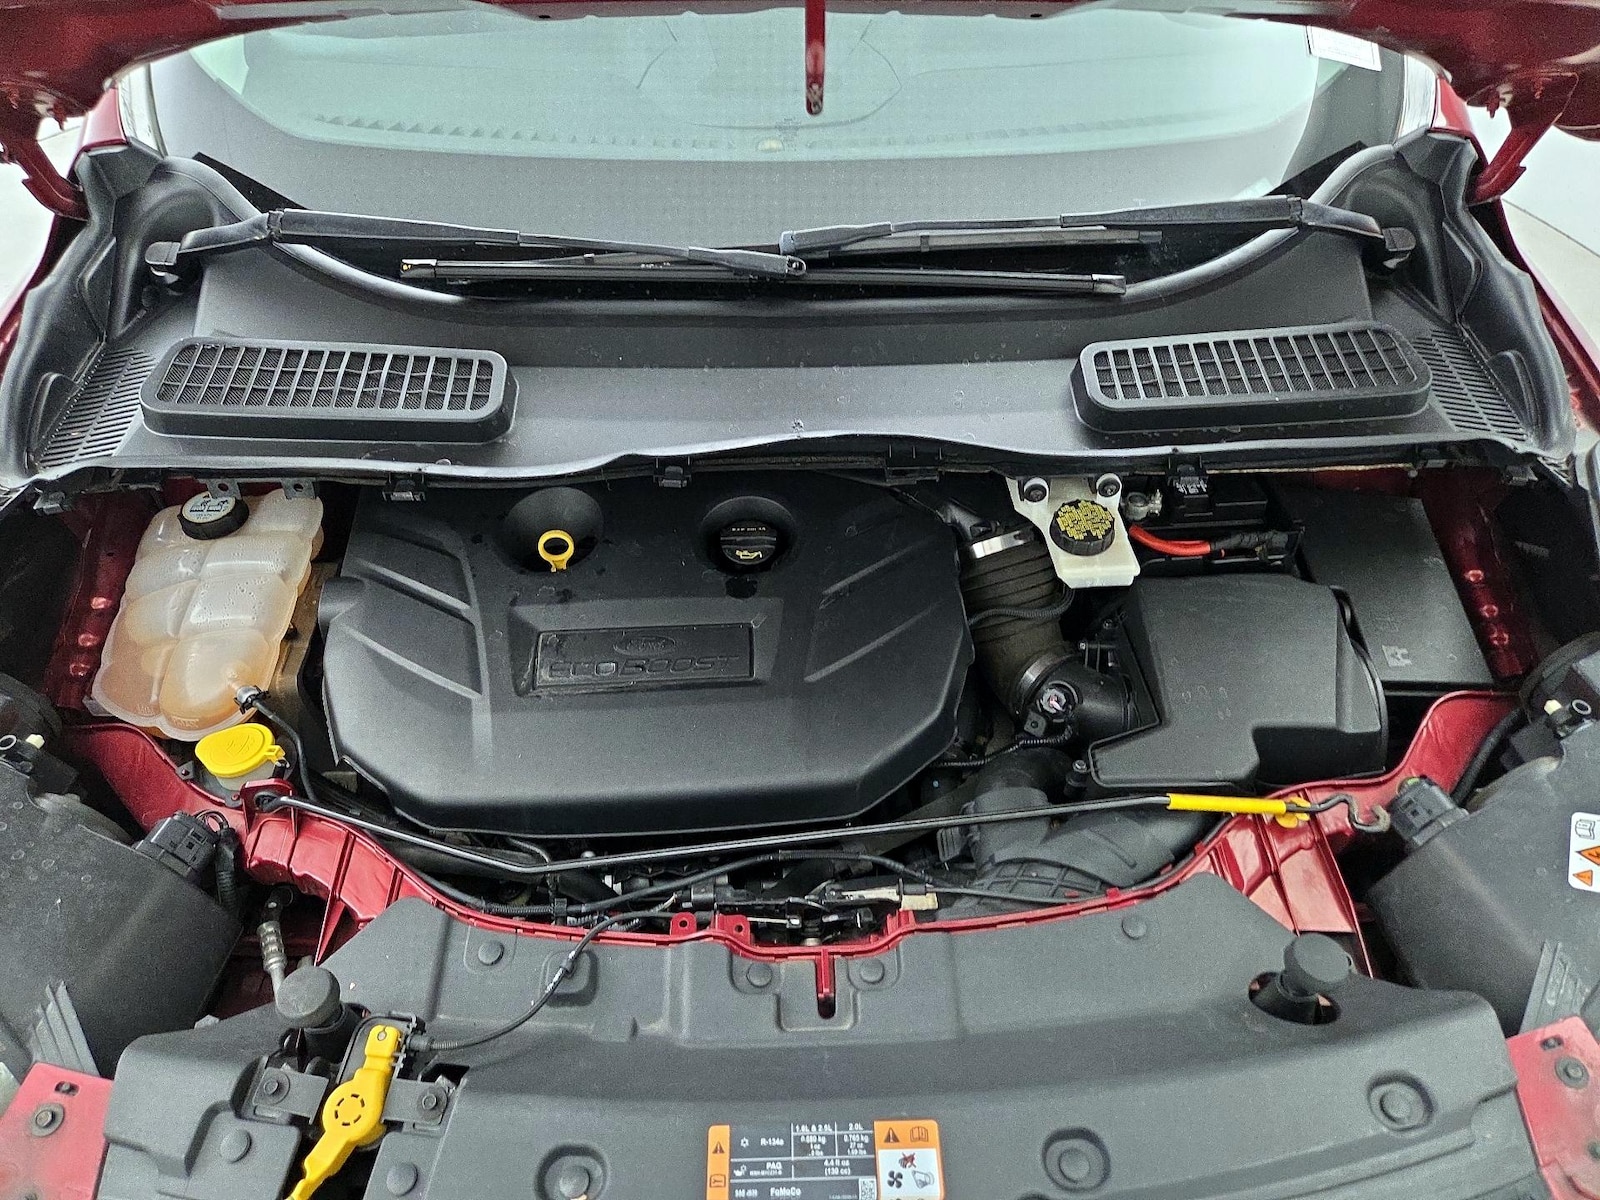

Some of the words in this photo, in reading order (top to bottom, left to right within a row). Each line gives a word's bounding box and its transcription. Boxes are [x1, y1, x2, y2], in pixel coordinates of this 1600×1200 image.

[848, 1122, 863, 1131] 2.0L
[760, 1137, 784, 1146] R-134a
[861, 1134, 869, 1143] kg
[766, 1162, 782, 1170] PAG
[770, 1186, 802, 1197] FoMoCo
